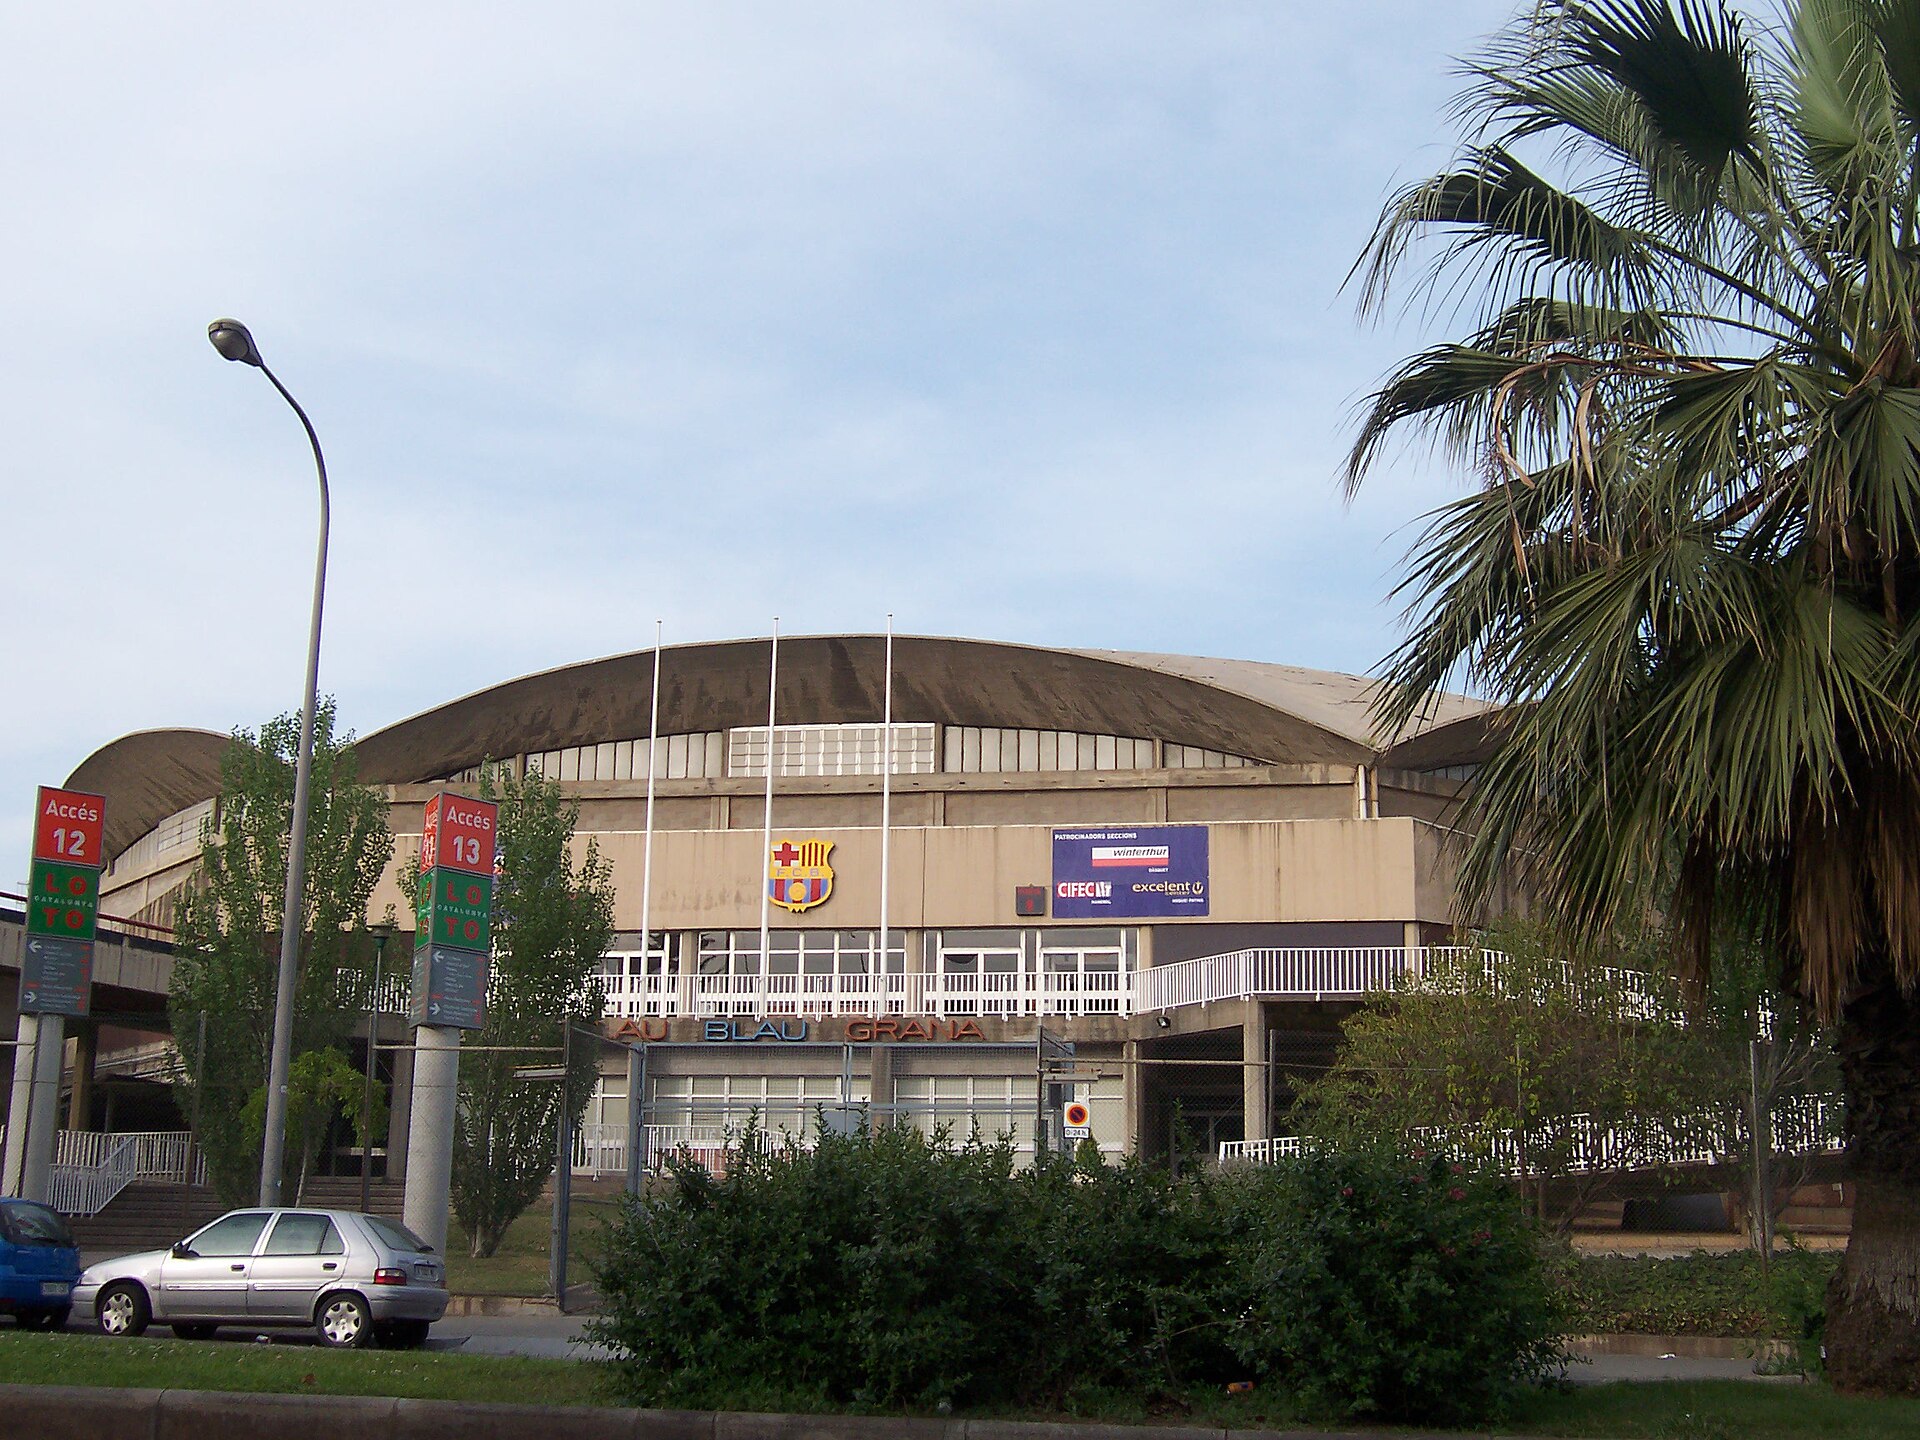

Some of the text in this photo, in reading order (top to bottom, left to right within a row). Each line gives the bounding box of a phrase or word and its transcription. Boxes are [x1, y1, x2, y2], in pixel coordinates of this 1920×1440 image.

[45, 798, 98, 822] Accés
[446, 805, 491, 830] Accés
[53, 827, 86, 857] 12
[1054, 831, 1138, 841] PATROCINADORS SECCIONS
[453, 835, 481, 865] 13
[1113, 847, 1168, 858] winterthur
[1132, 881, 1190, 892] excelent
[436, 904, 488, 919] CATALUNYA
[704, 1019, 808, 1042] BLAU
[844, 1018, 987, 1042] GRANA
